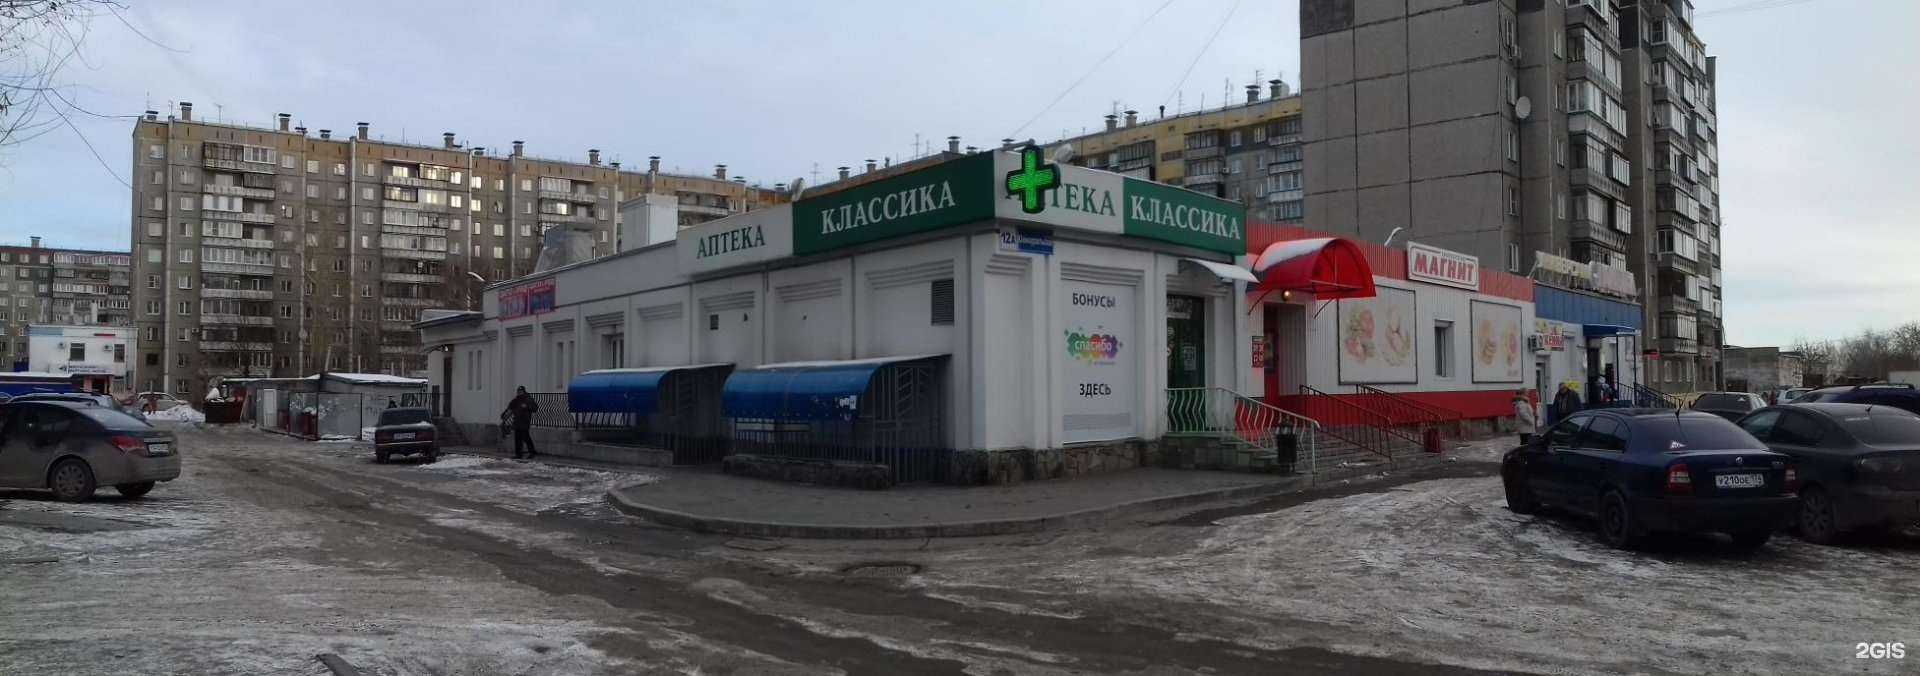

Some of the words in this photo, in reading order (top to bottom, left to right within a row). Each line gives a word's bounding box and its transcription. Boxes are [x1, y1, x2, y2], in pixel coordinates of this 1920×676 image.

[696, 224, 766, 259] АПТЕКА
[820, 180, 956, 235] КЛАССИКА
[1005, 182, 1117, 217] ТЕКА
[1130, 195, 1241, 240] КЛАССИКА
[1414, 251, 1475, 283] МАГНИТ
[1072, 293, 1116, 307] БОНУСЫ
[1079, 383, 1112, 397] ЗДЕСЬ
